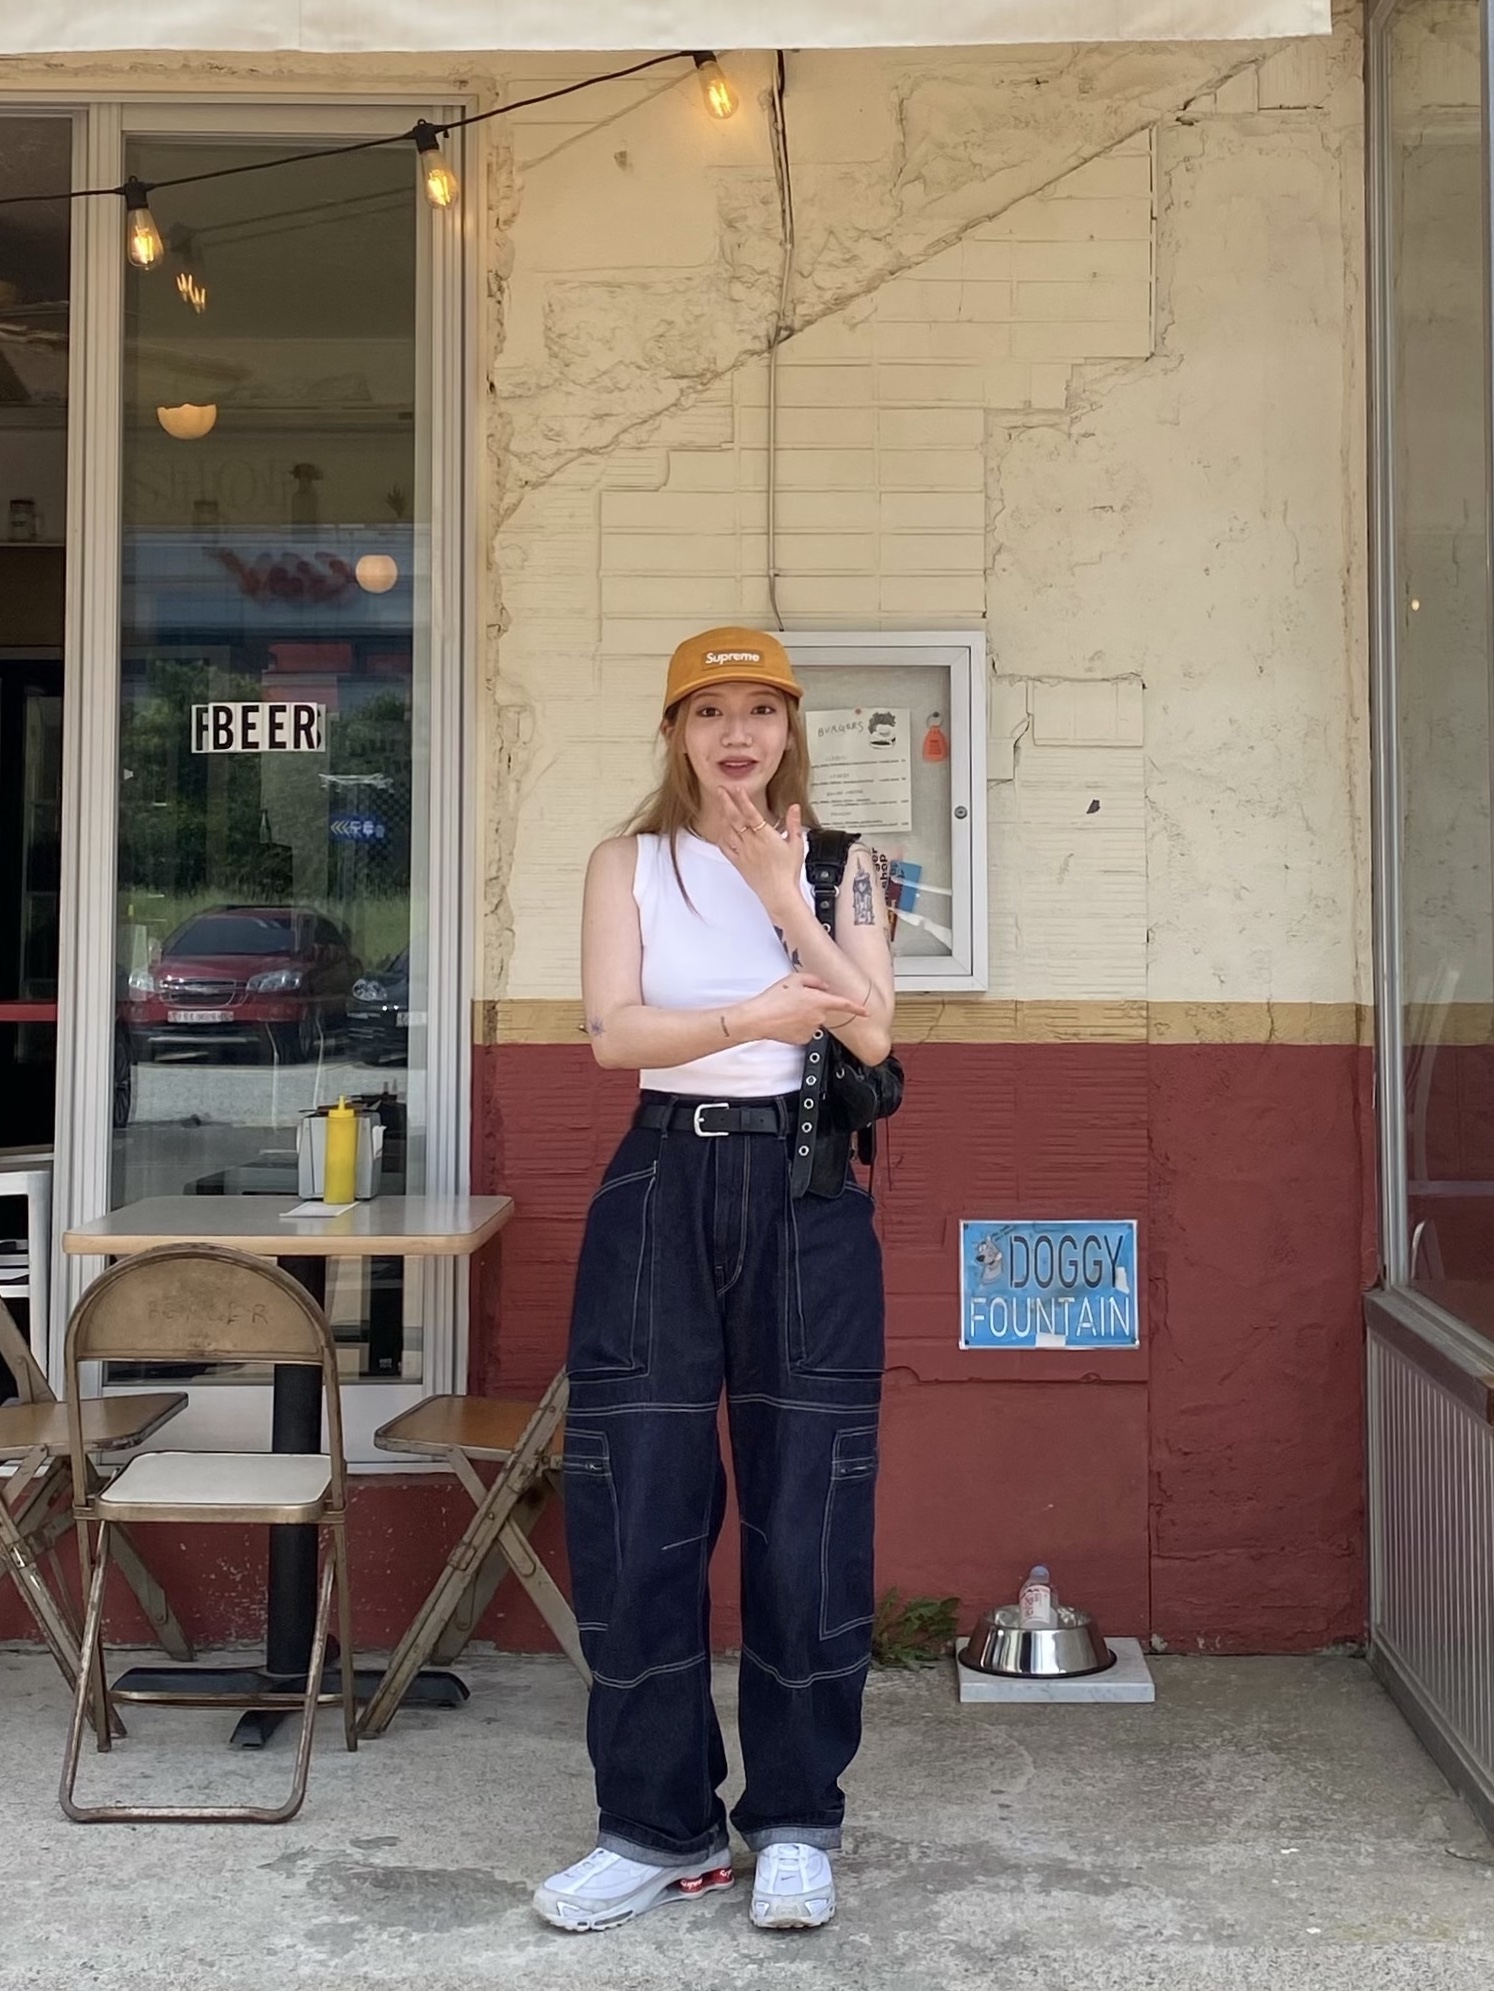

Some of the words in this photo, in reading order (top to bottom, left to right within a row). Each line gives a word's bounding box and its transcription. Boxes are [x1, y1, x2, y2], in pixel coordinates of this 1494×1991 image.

[705, 652, 760, 665] Supreme
[817, 721, 864, 738] BURGERS
[1009, 1234, 1123, 1289] DOGGY
[970, 1296, 1131, 1338] FOUNTAIN
